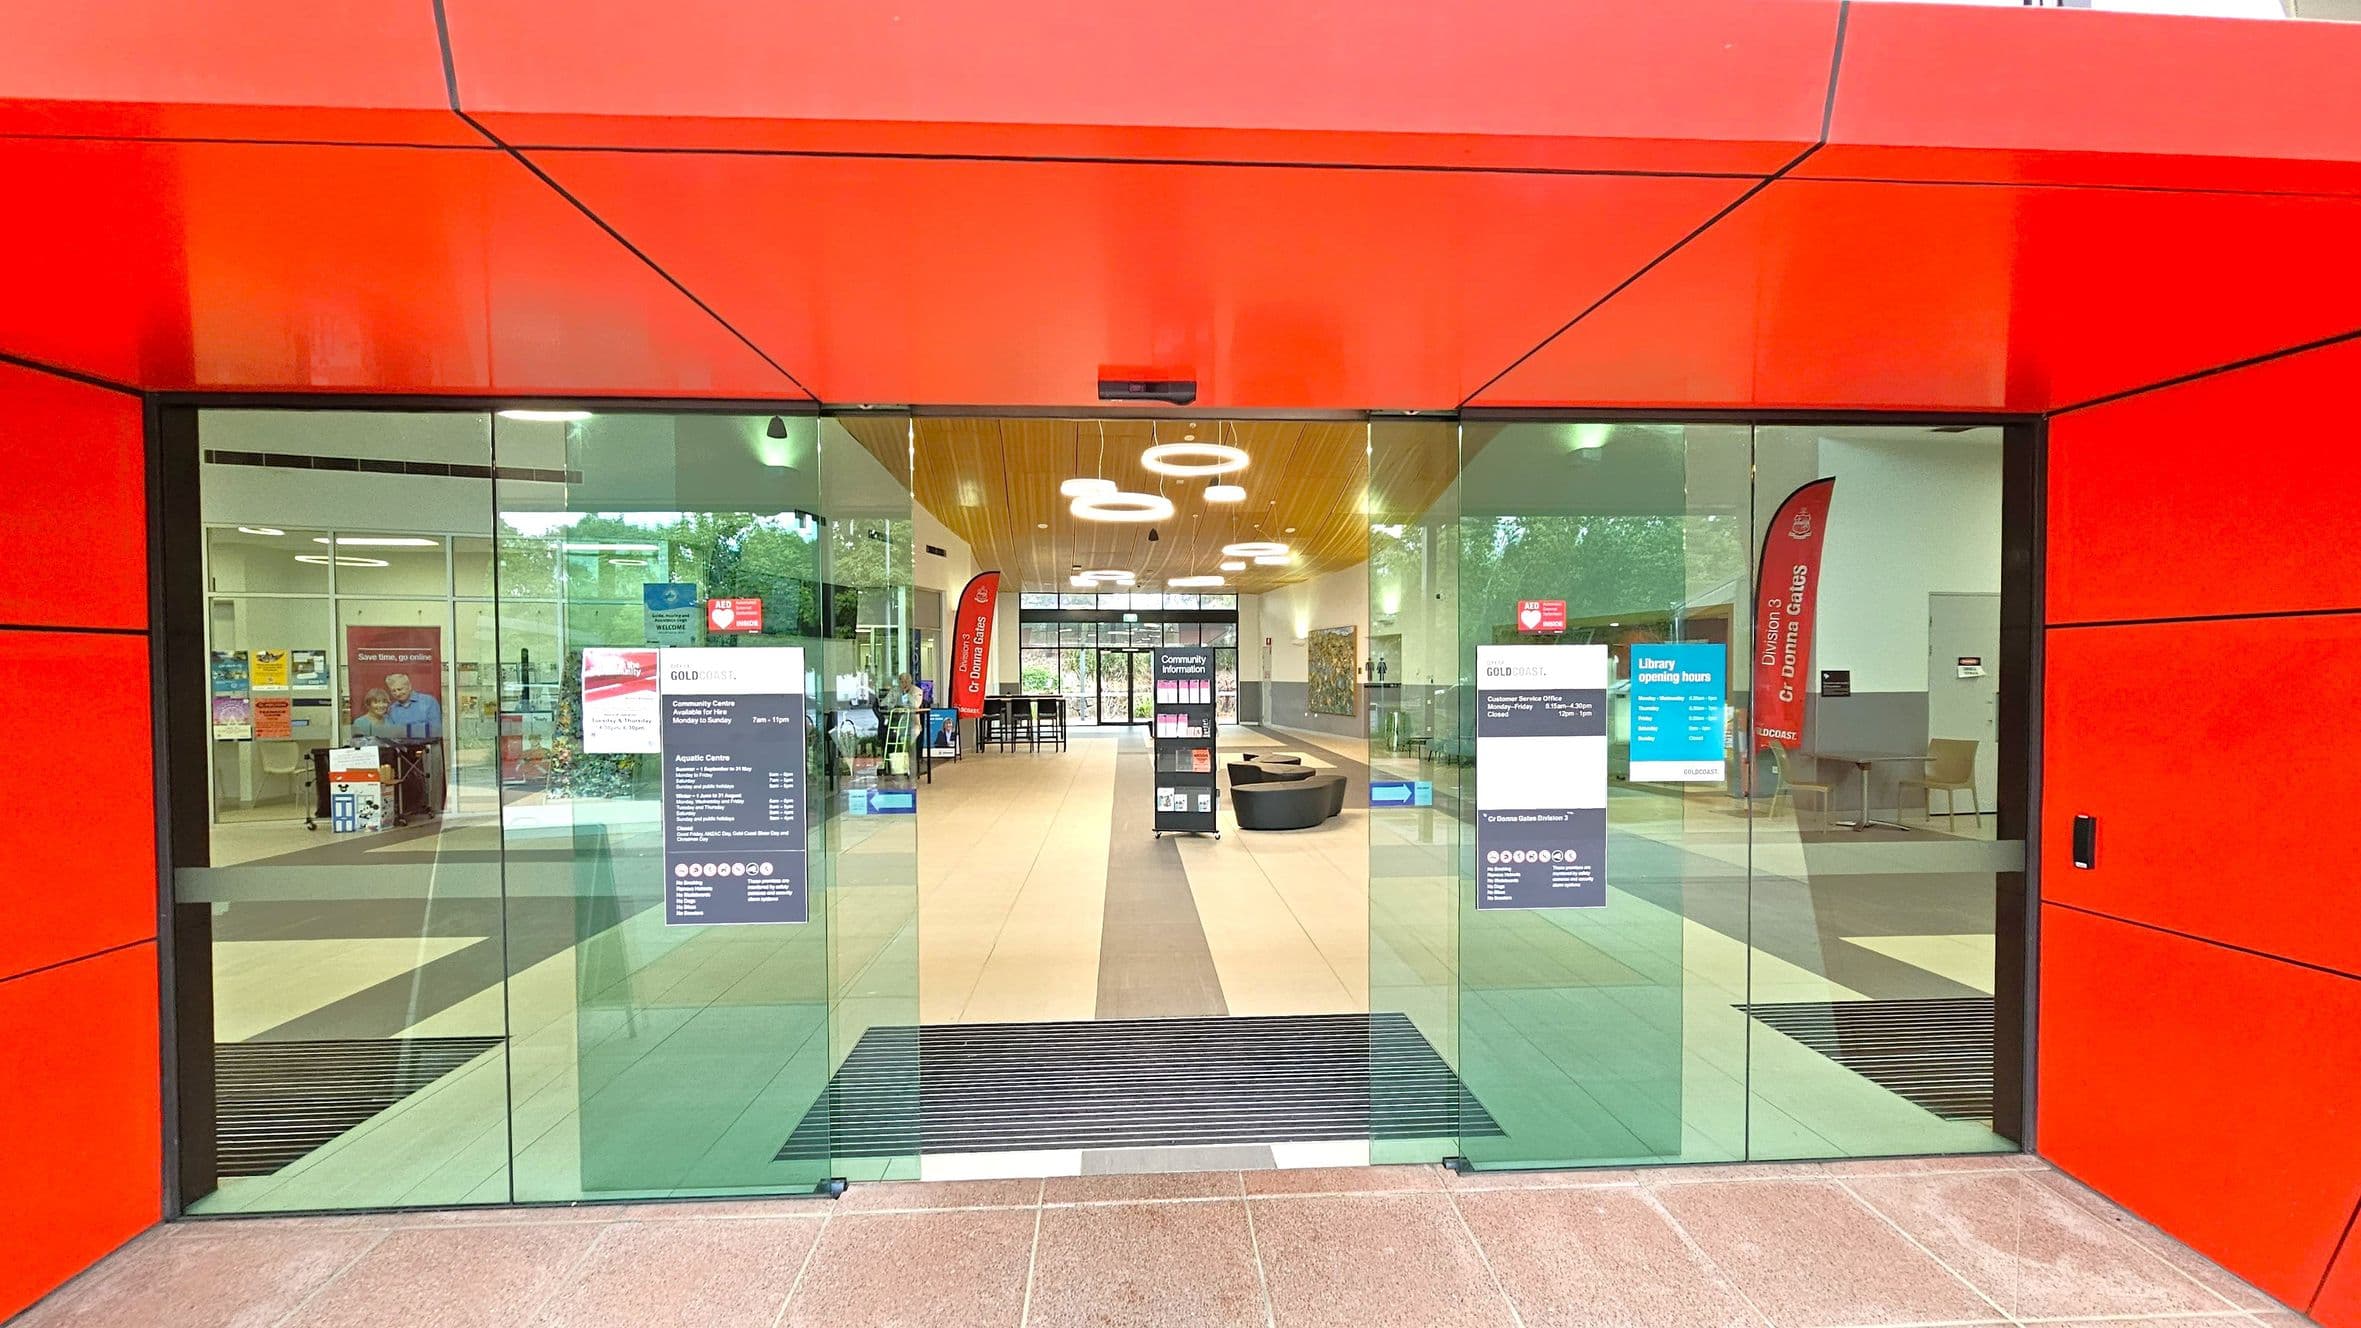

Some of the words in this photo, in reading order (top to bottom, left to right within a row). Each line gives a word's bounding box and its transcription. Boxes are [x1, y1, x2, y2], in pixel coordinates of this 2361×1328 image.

[1787, 564, 1808, 616] Gates
[715, 599, 731, 608] AED
[1769, 598, 1782, 608] 3
[973, 616, 986, 645] Gates
[1762, 608, 1781, 666] Division
[1781, 621, 1799, 680] Donna
[358, 653, 377, 661] Save
[378, 653, 397, 662] time,
[398, 655, 409, 663] go
[410, 653, 432, 661] online
[959, 643, 970, 673] Division
[970, 647, 983, 679] Donna
[1161, 655, 1206, 665] Community
[1162, 664, 1206, 674] Information
[1638, 658, 1675, 671] Library
[1638, 672, 1680, 685] opening
[1682, 671, 1712, 682] hours
[969, 682, 979, 693] Cr
[1779, 682, 1793, 702] Cr
[672, 700, 711, 708] Community
[672, 708, 702, 716] Available
[703, 708, 712, 716] for
[714, 708, 728, 716] Hire
[672, 717, 698, 725] Monday
[707, 717, 732, 725] Sunday
[752, 716, 767, 724] 7am
[772, 716, 790, 724] 11pm
[676, 755, 704, 763] Aquatic
[705, 754, 730, 762] Centre
